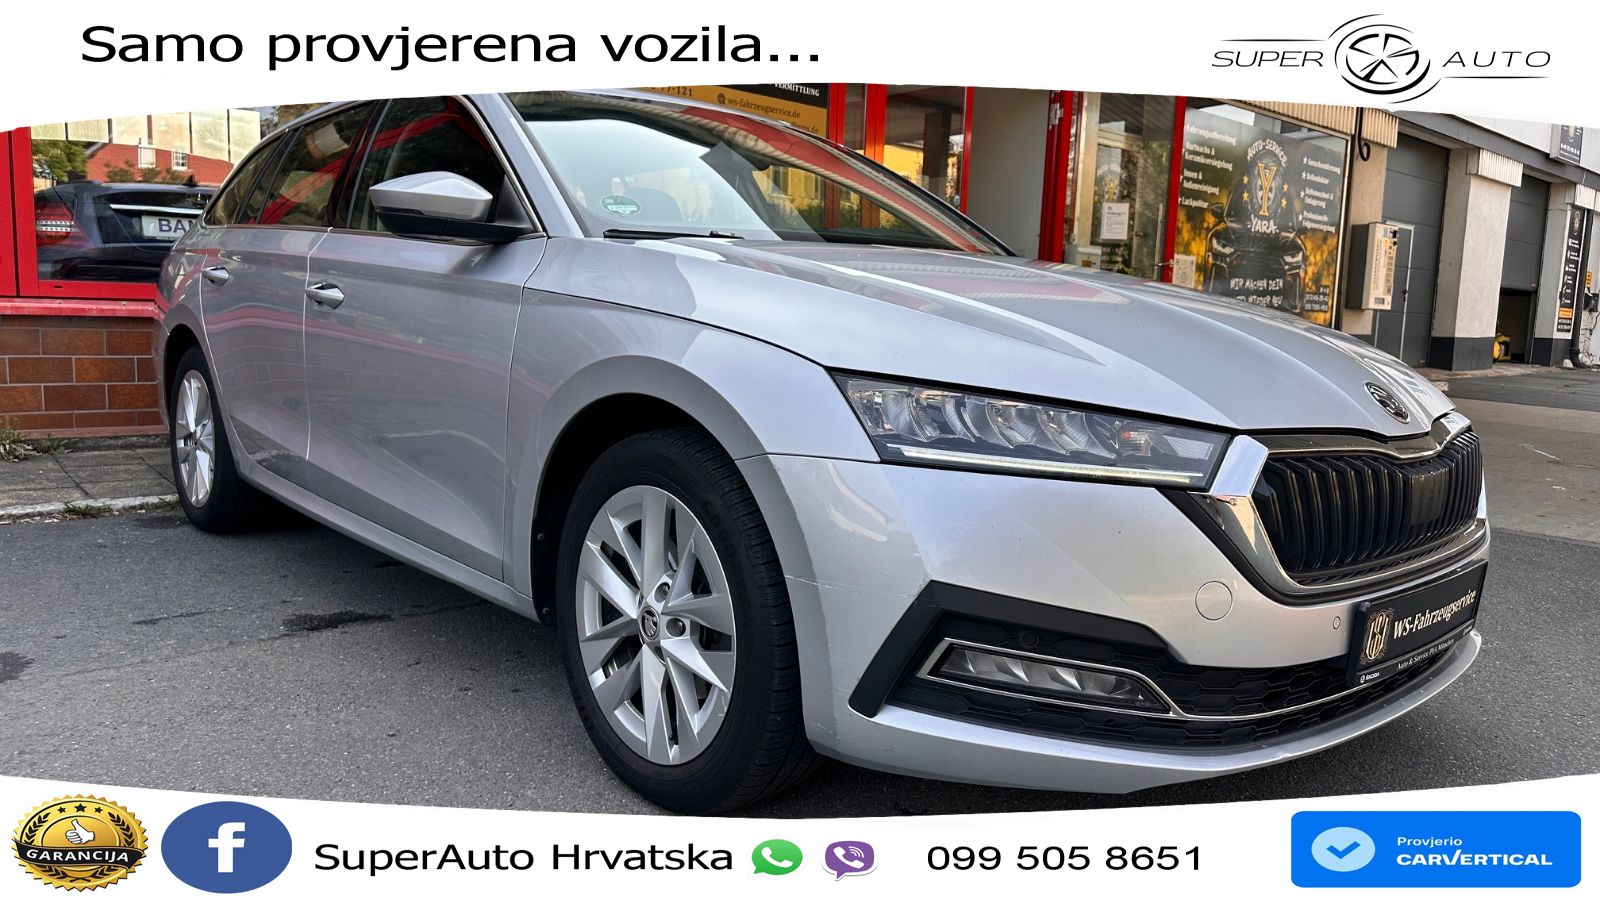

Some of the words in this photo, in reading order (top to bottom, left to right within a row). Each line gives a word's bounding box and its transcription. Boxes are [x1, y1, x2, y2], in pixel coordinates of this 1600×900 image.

[727, 97, 801, 118] ws-fahrzeugservice.de
[1247, 138, 1288, 167] AUTO-SERVICE
[158, 218, 196, 233] BA
[1229, 278, 1244, 290] WIR
[1245, 278, 1267, 291] MACHEN
[1268, 278, 1283, 290] DEIN
[1393, 589, 1477, 639] WS-Fahrzeugservice
